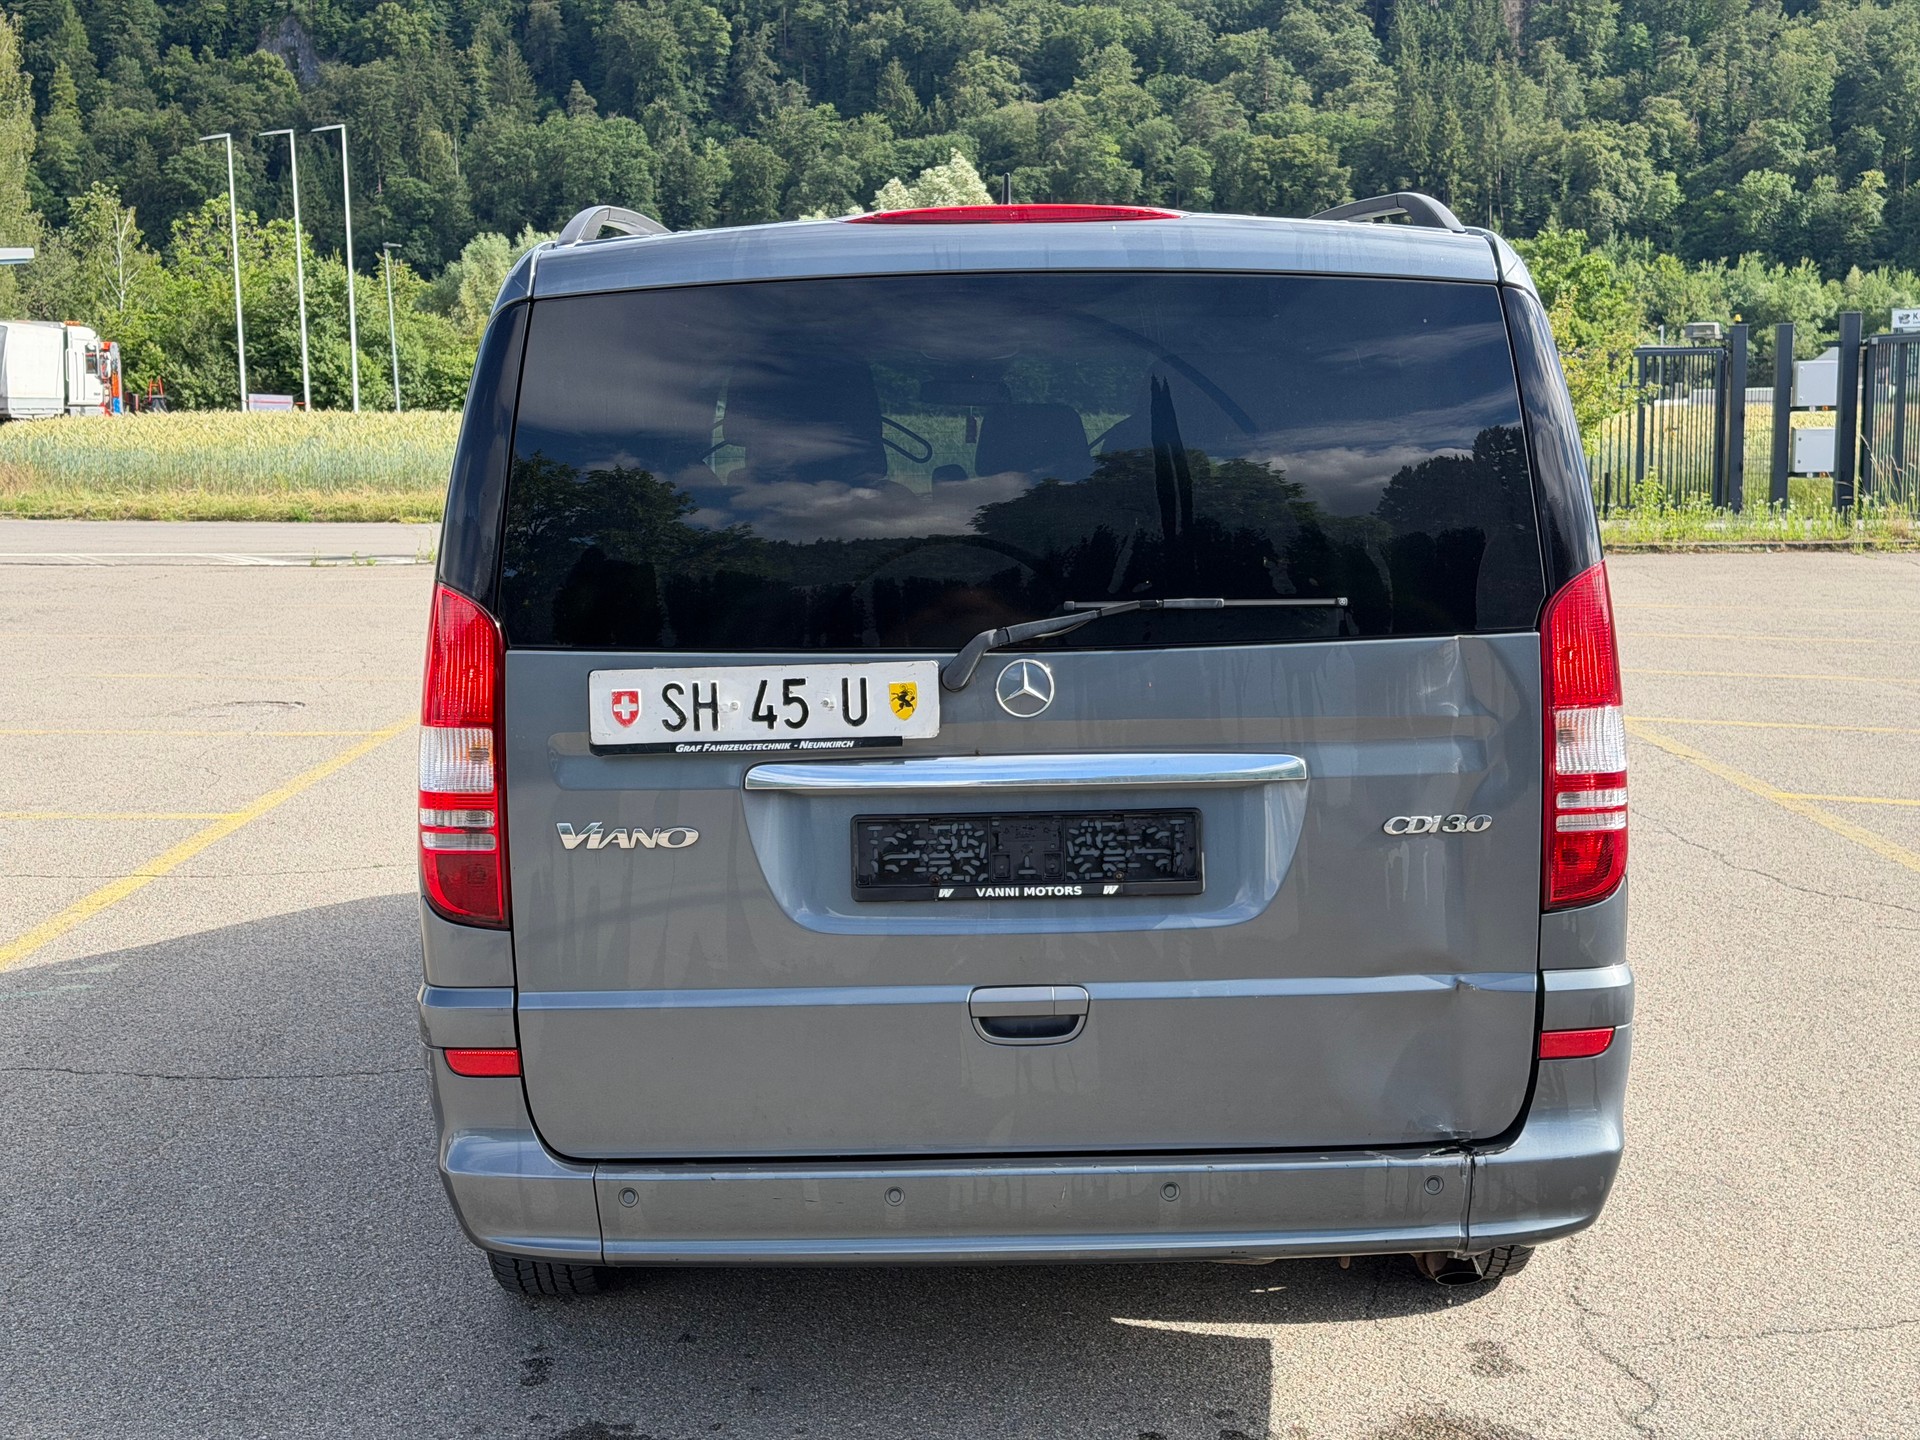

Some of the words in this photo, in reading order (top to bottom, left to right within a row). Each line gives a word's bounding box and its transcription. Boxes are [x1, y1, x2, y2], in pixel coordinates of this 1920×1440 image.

[661, 681, 719, 732] SH
[751, 677, 809, 730] 45
[841, 676, 868, 727] U
[675, 743, 703, 753] GRAF
[702, 741, 791, 752] FAHRZEUGTECHNIK
[798, 739, 855, 749] NEUNKIRCH
[975, 887, 1019, 897] VANNI
[1023, 885, 1083, 896] MOTORS
